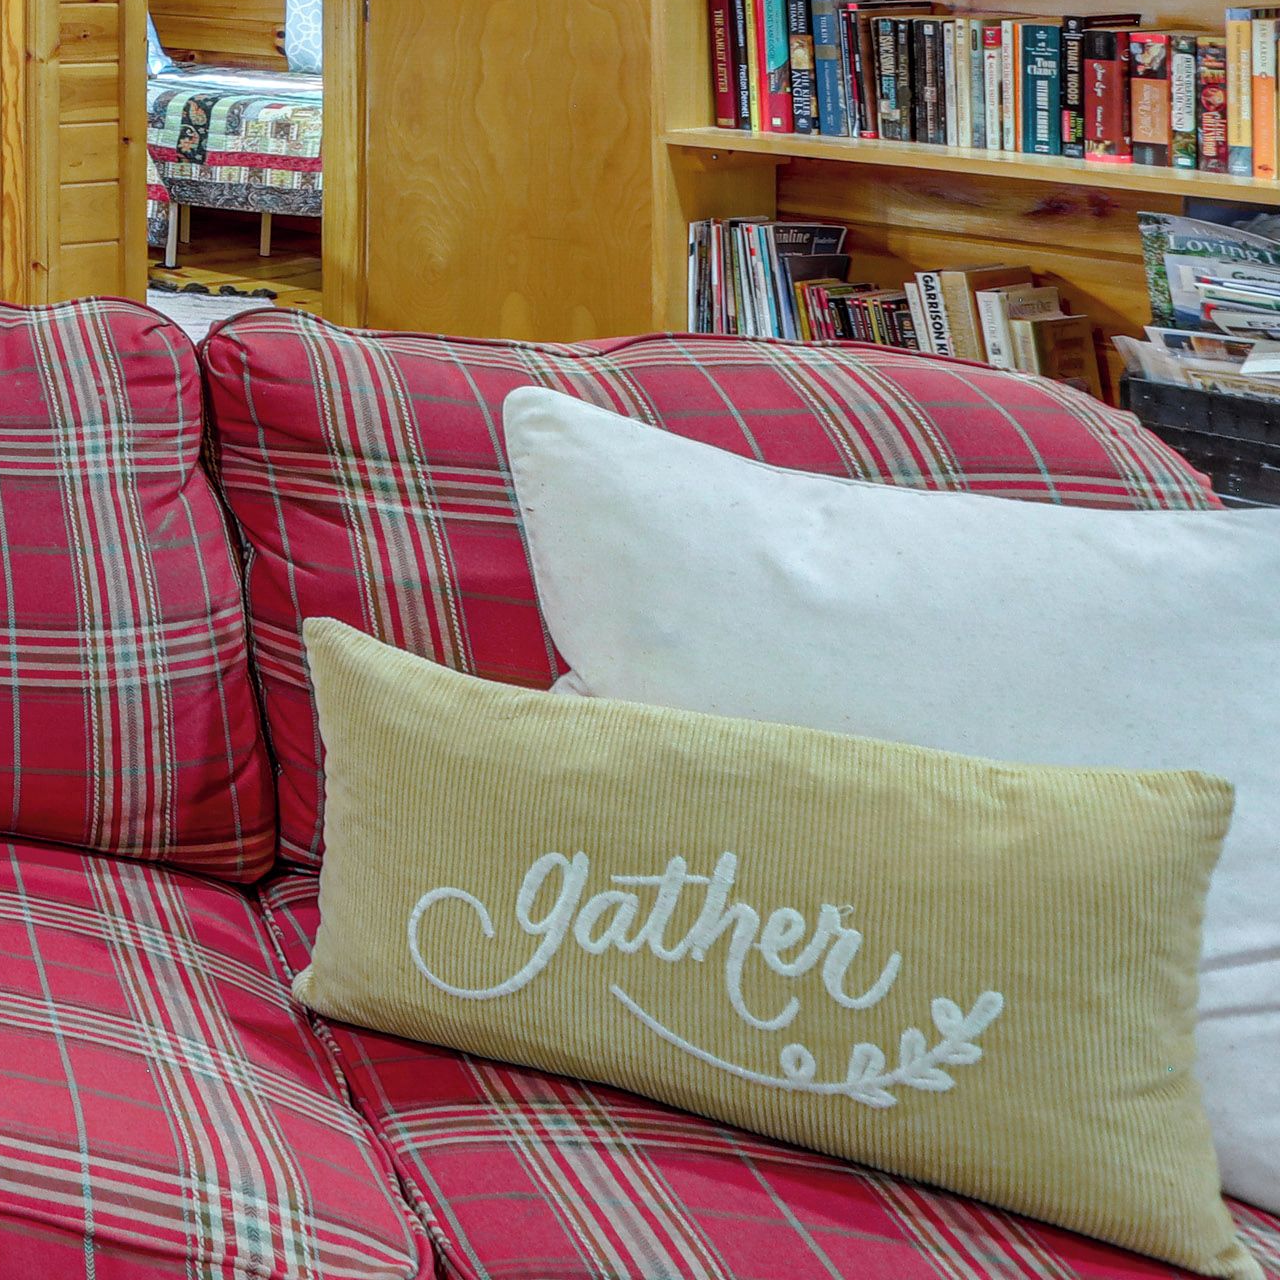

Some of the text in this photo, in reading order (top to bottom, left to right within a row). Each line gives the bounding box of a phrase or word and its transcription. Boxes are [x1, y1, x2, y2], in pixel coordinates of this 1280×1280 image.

[797, 1, 806, 33] MICHAEL
[820, 16, 828, 44] TOLKIEN
[714, 10, 727, 93] THE SCARLET LETTER
[881, 54, 895, 76] ASIMOV
[1037, 58, 1057, 68] Tom
[1067, 41, 1079, 71] STUART
[899, 64, 908, 87] GIVER
[1027, 65, 1057, 77] Clancy
[739, 64, 749, 117] Preston Dennett
[791, 71, 803, 115] ANGELS
[801, 71, 811, 116] THE KILLER
[1067, 74, 1080, 105] WOODS
[1037, 80, 1049, 141] WITHOUT REMORSE
[1202, 112, 1220, 156] GREENWOOD
[1168, 233, 1262, 264] Loving
[922, 275, 945, 340] GARRISON
[409, 851, 902, 1031] gather
